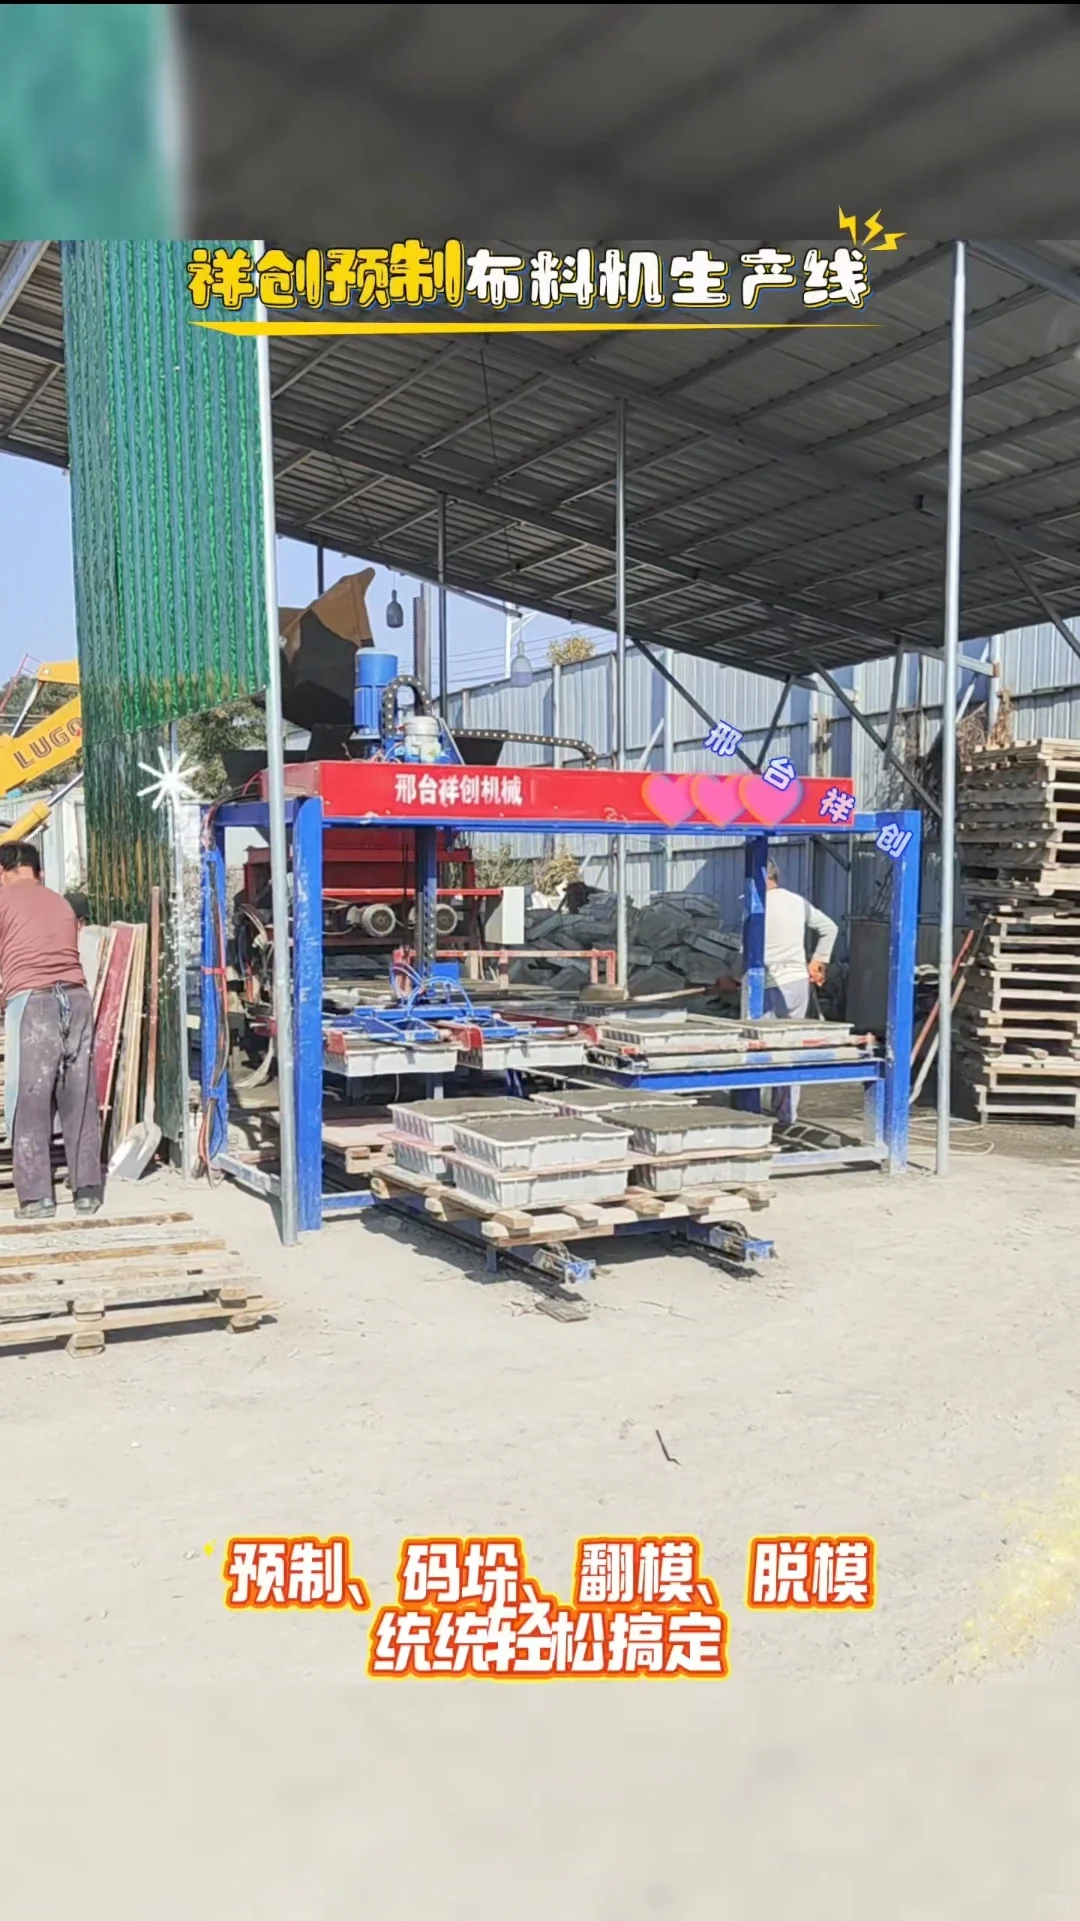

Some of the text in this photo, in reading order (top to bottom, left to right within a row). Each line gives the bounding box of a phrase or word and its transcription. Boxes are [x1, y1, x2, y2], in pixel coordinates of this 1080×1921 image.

[395, 773, 523, 807] 邢台祥创机械
